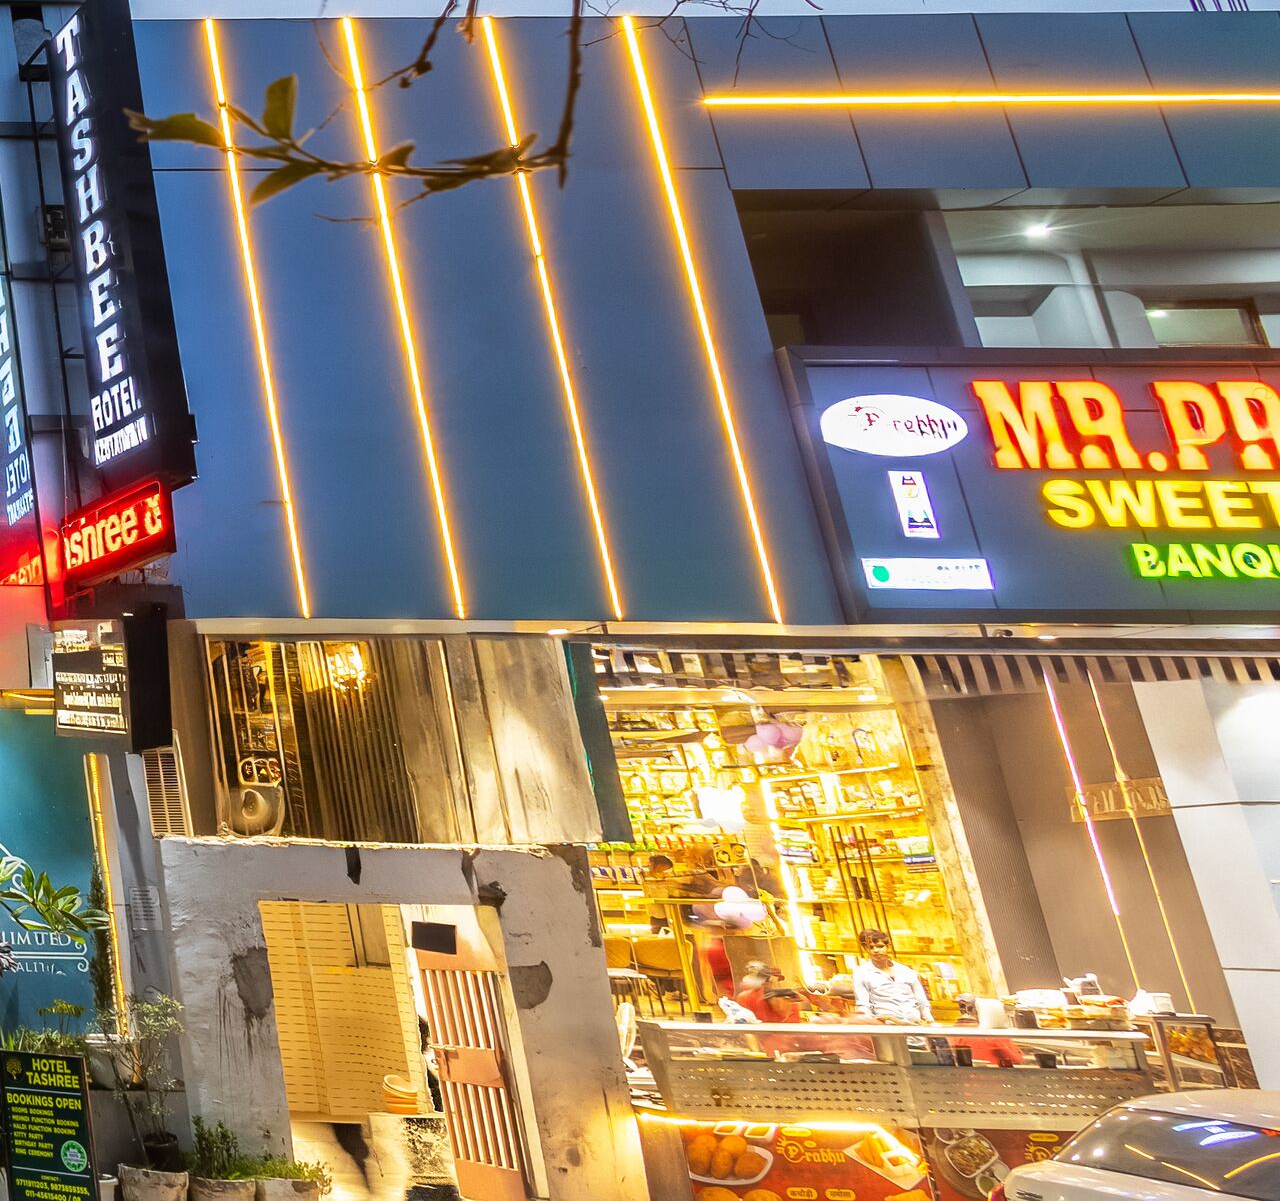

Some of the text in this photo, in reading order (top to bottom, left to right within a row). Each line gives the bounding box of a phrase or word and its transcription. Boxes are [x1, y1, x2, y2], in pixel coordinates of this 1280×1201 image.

[32, 1058, 71, 1074] HOTEL
[25, 1071, 80, 1089] TASHREE
[6, 1092, 82, 1110] BOOKINGS OPEN
